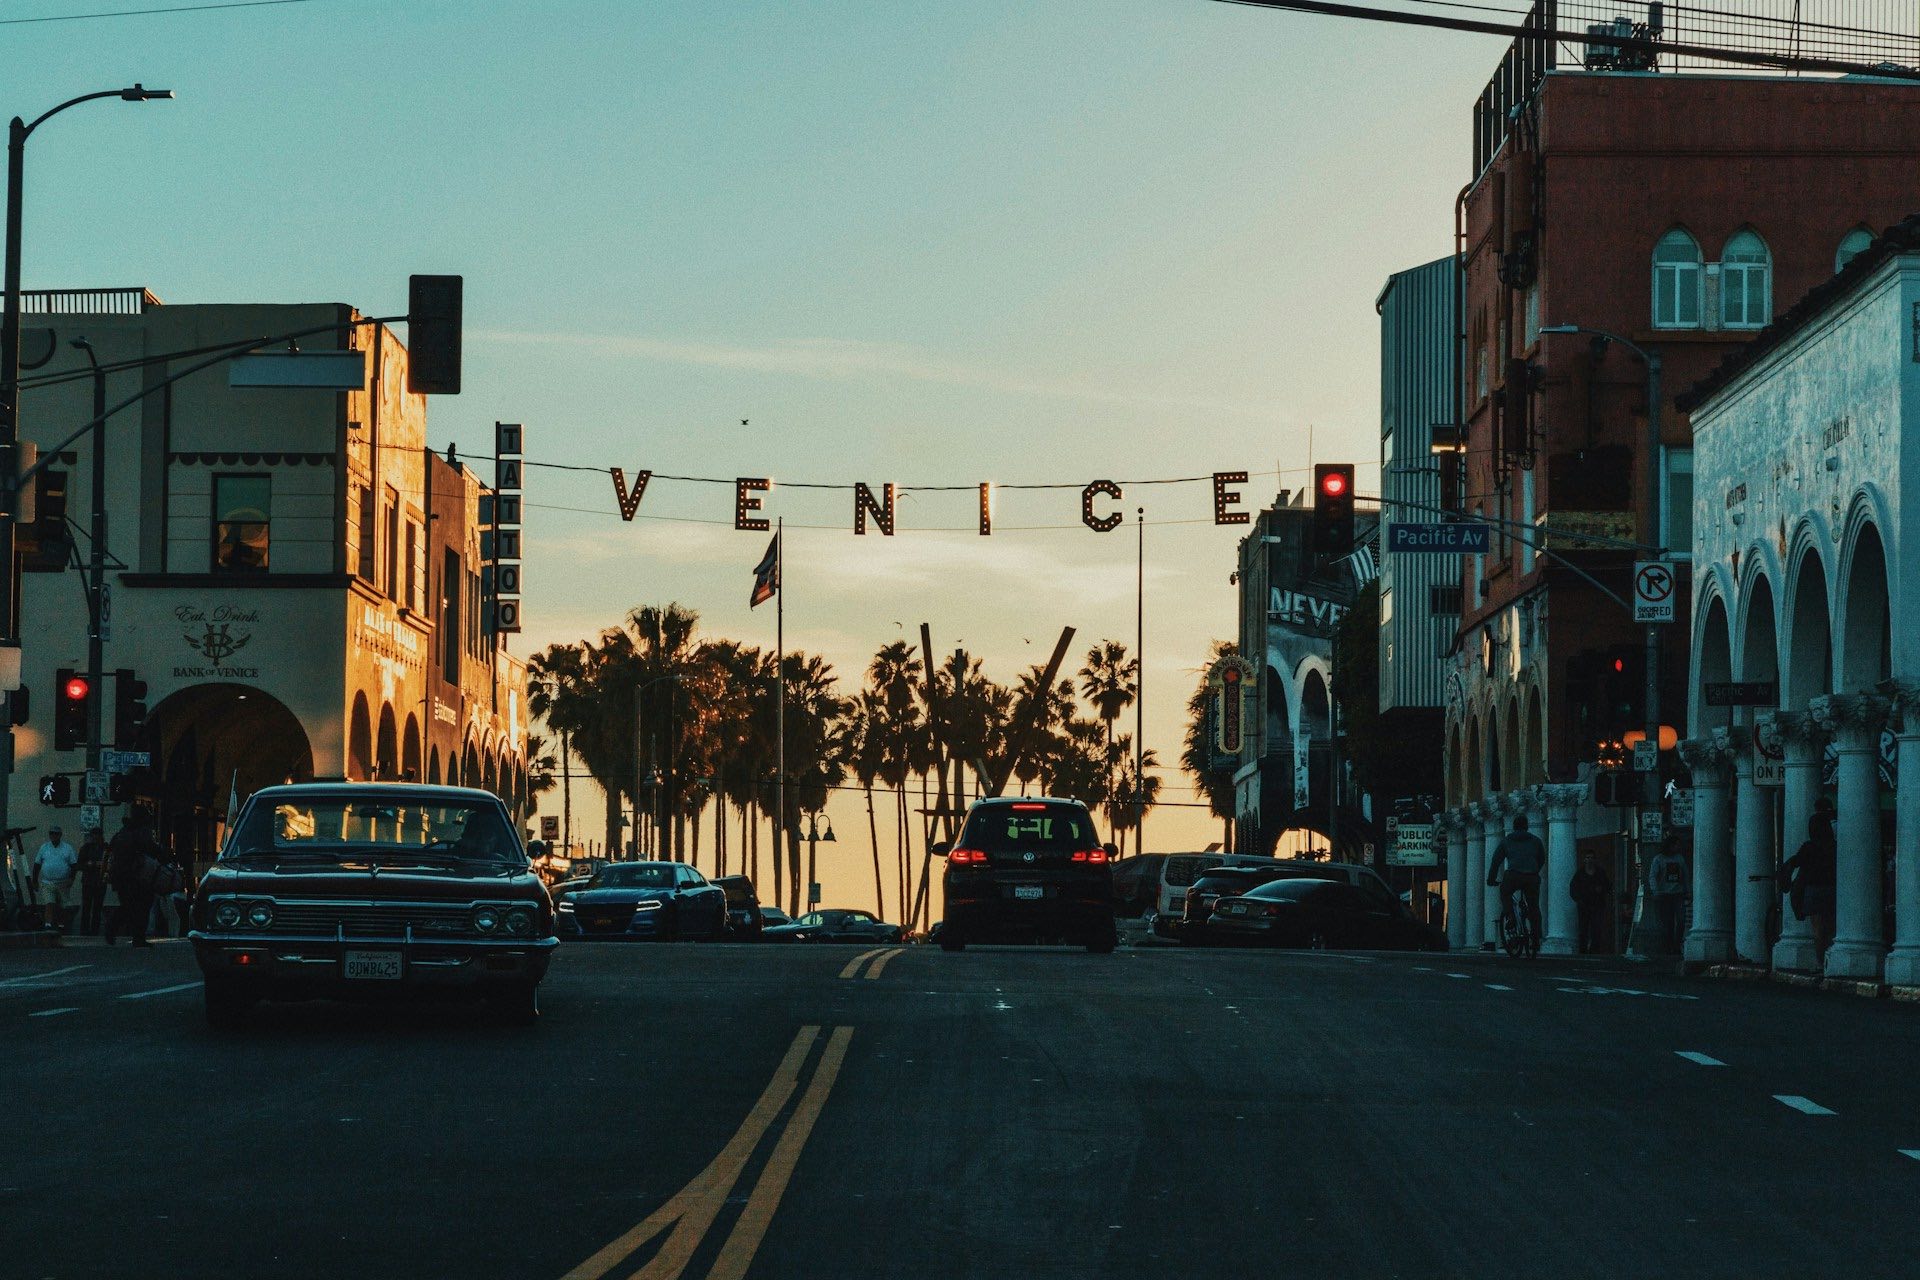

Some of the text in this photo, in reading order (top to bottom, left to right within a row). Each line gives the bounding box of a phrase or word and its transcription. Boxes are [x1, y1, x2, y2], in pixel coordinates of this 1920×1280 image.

[610, 467, 1250, 536] VENICE
[501, 428, 518, 625] TATTOO
[1397, 529, 1483, 545] Pacific Av
[175, 605, 260, 622] Eat. Drink.
[173, 667, 205, 677] BANK
[216, 667, 259, 678] VENICE
[1757, 765, 1773, 778] ON
[1395, 830, 1432, 840] PUBLIC
